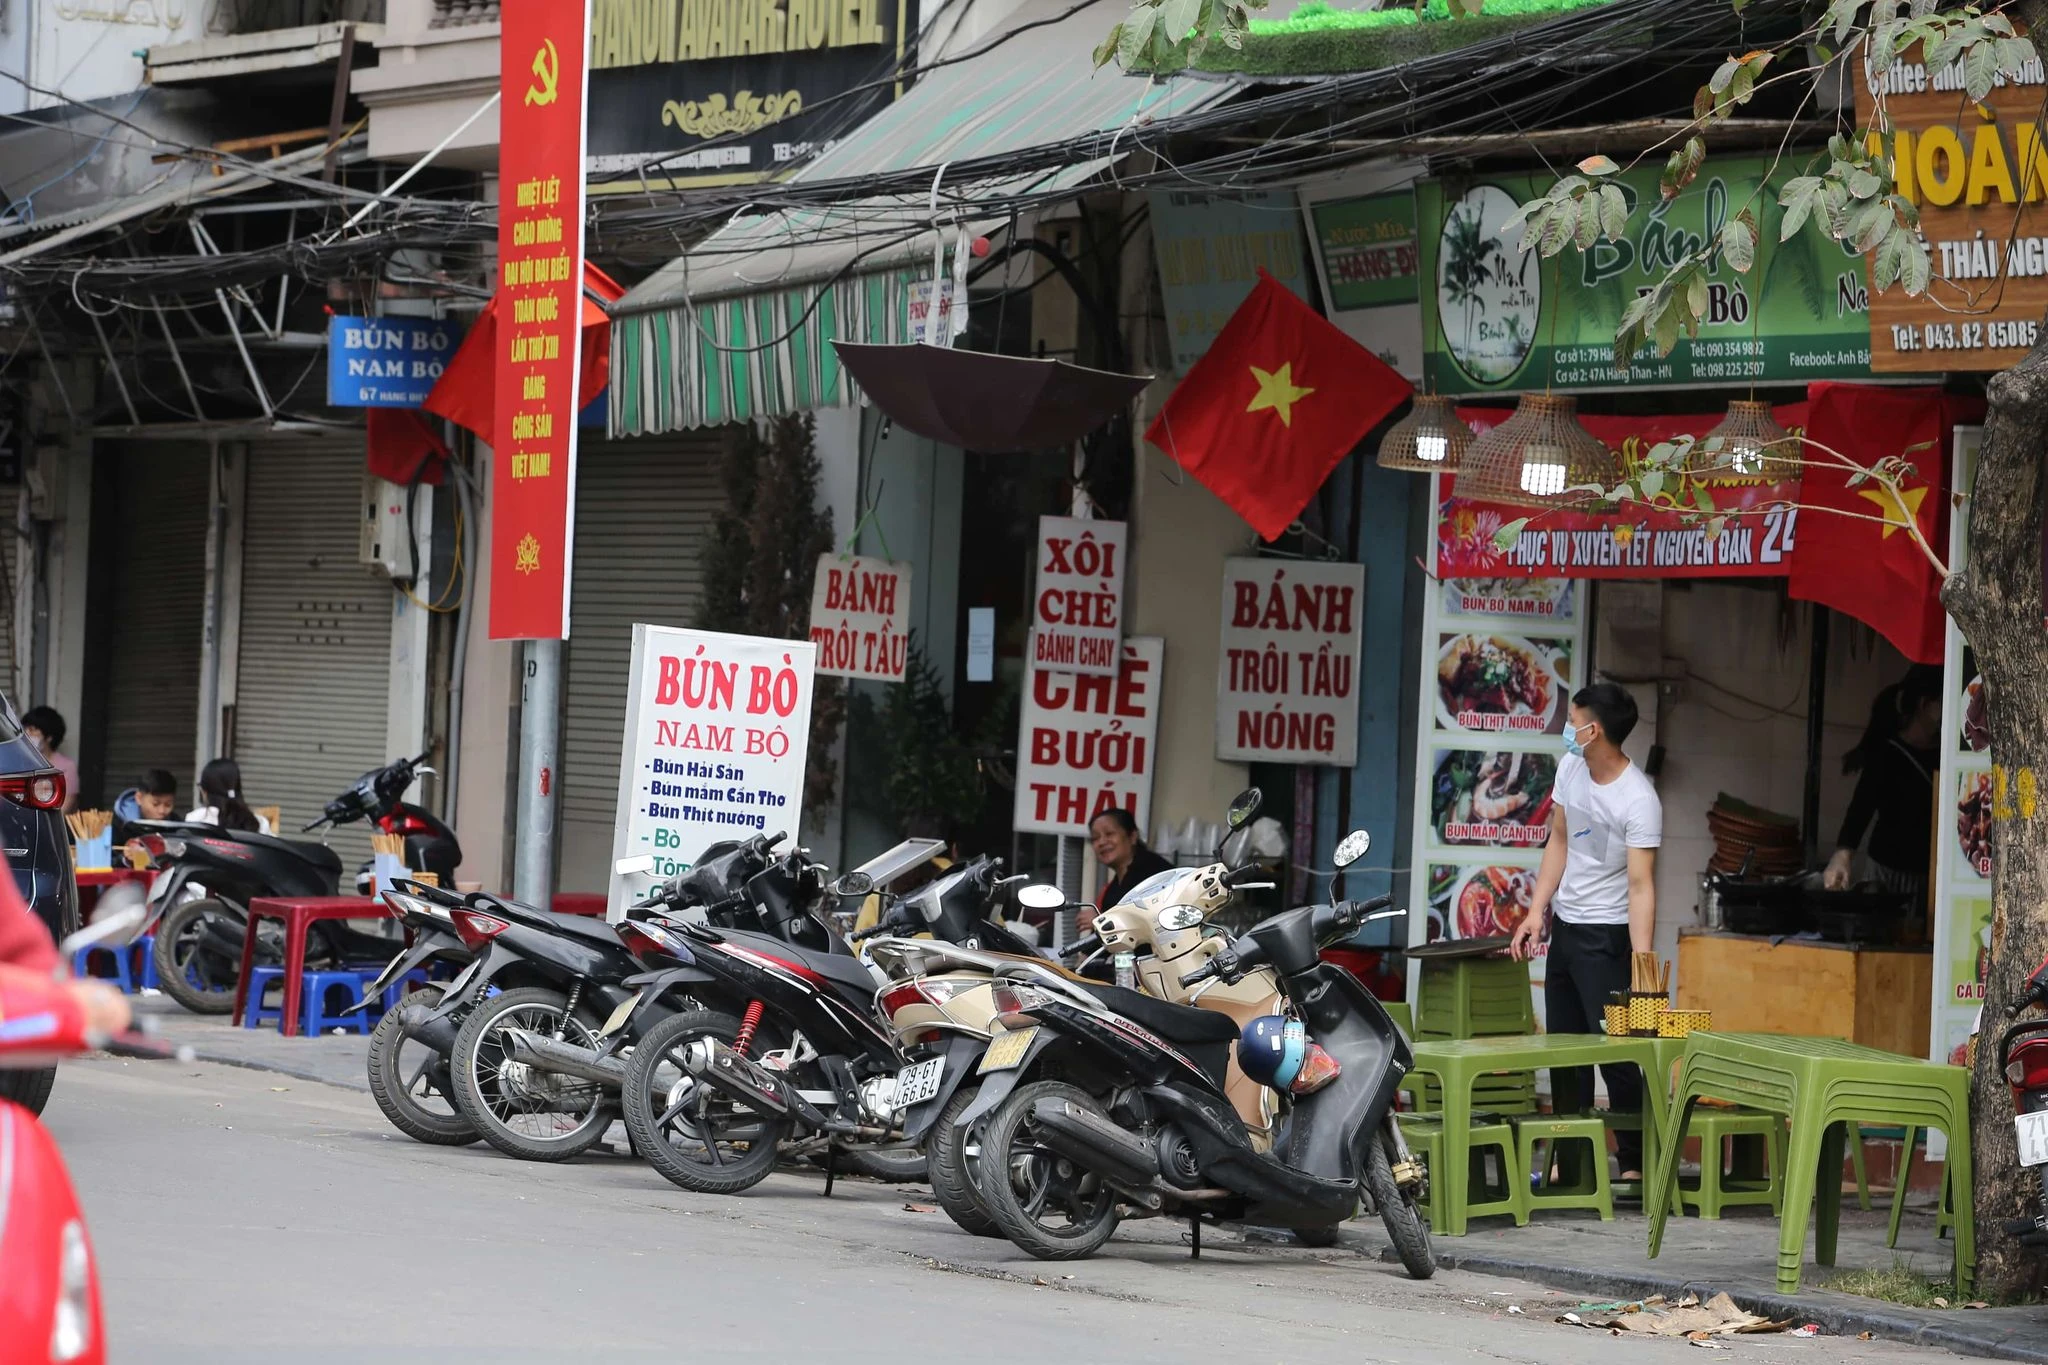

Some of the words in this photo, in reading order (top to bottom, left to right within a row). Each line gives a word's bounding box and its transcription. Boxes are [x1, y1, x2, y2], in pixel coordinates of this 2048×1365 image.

[1937, 229, 1998, 280] THÁI
[2005, 236, 2048, 280] NG
[1708, 278, 1749, 325] Bò
[1838, 269, 1870, 319] Na
[344, 324, 404, 351] BÚN
[1707, 343, 1723, 357] 090
[1724, 342, 1741, 356] 354
[1891, 322, 1921, 352] Tel:
[1924, 321, 1985, 350] 043.82
[1987, 319, 2038, 349] 85085
[348, 358, 405, 378] NAM
[1707, 363, 1724, 377] 098
[1725, 362, 1742, 377] 225
[1789, 350, 1836, 367] Facebook:
[1837, 350, 1856, 365] Anh
[359, 387, 378, 402] 67
[1043, 529, 1117, 579] XÔI
[825, 560, 898, 616] BÁNH
[1038, 581, 1118, 629] CHÈ
[1231, 568, 1355, 635] BÁNH
[1507, 600, 1535, 614] NAM
[809, 618, 859, 672] TRÔI
[863, 618, 907, 676] TẦU
[1036, 627, 1075, 665] BÁNH
[1079, 635, 1115, 668] CHAY
[654, 644, 740, 713] BÚN
[745, 653, 799, 718] BÒ
[1032, 645, 1150, 719] CHÈ
[1226, 641, 1289, 695] TRÔI
[1298, 640, 1352, 699] TẦU
[654, 719, 736, 753] NAM
[743, 724, 790, 763] BỘ
[1030, 719, 1147, 775] BƯỞI
[1236, 702, 1336, 753] NÓNG
[653, 757, 684, 776] Bún
[651, 780, 682, 798] Bún
[648, 802, 680, 820] Bún
[682, 805, 714, 825] Thịt
[654, 827, 681, 849] Bò
[1956, 981, 1974, 999] CÁ
